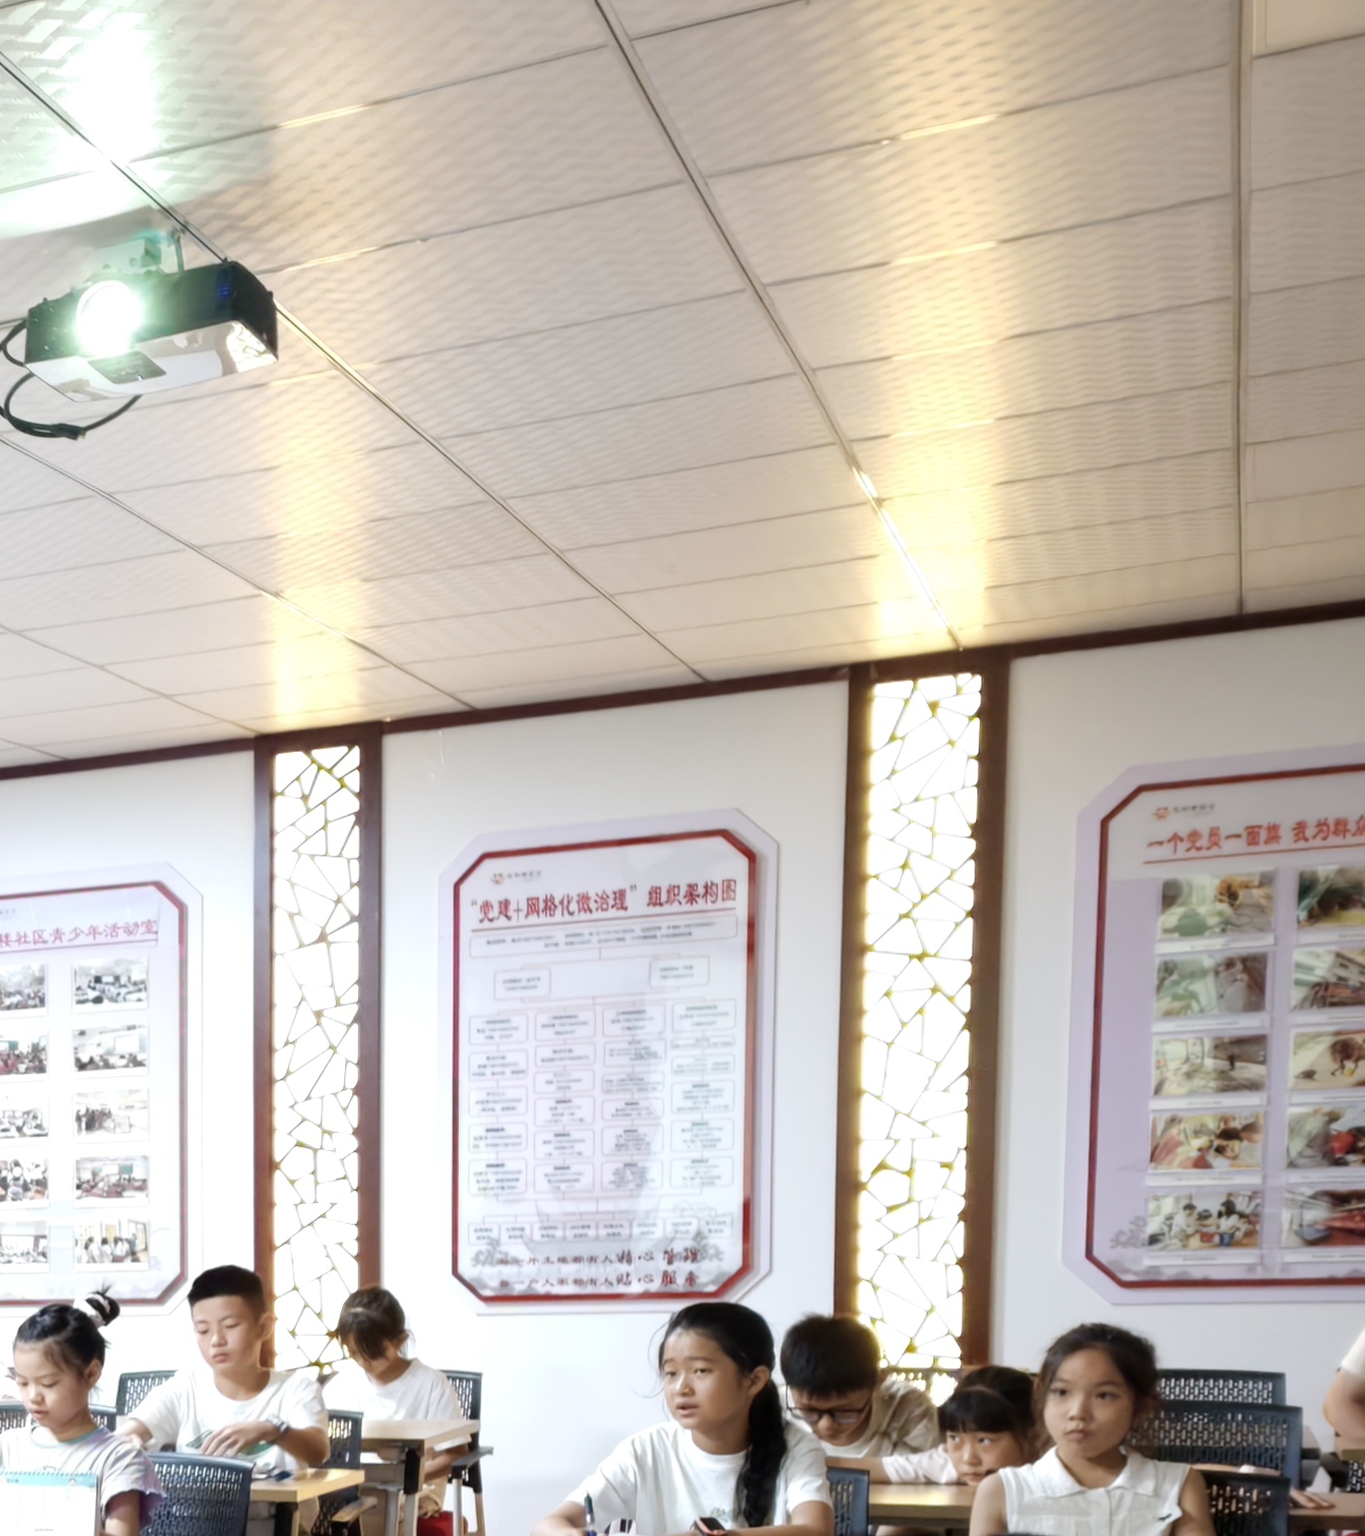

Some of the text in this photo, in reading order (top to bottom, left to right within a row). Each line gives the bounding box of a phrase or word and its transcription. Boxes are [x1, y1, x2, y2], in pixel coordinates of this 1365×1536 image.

[1146, 822, 1283, 854] 一个党员一面旗
